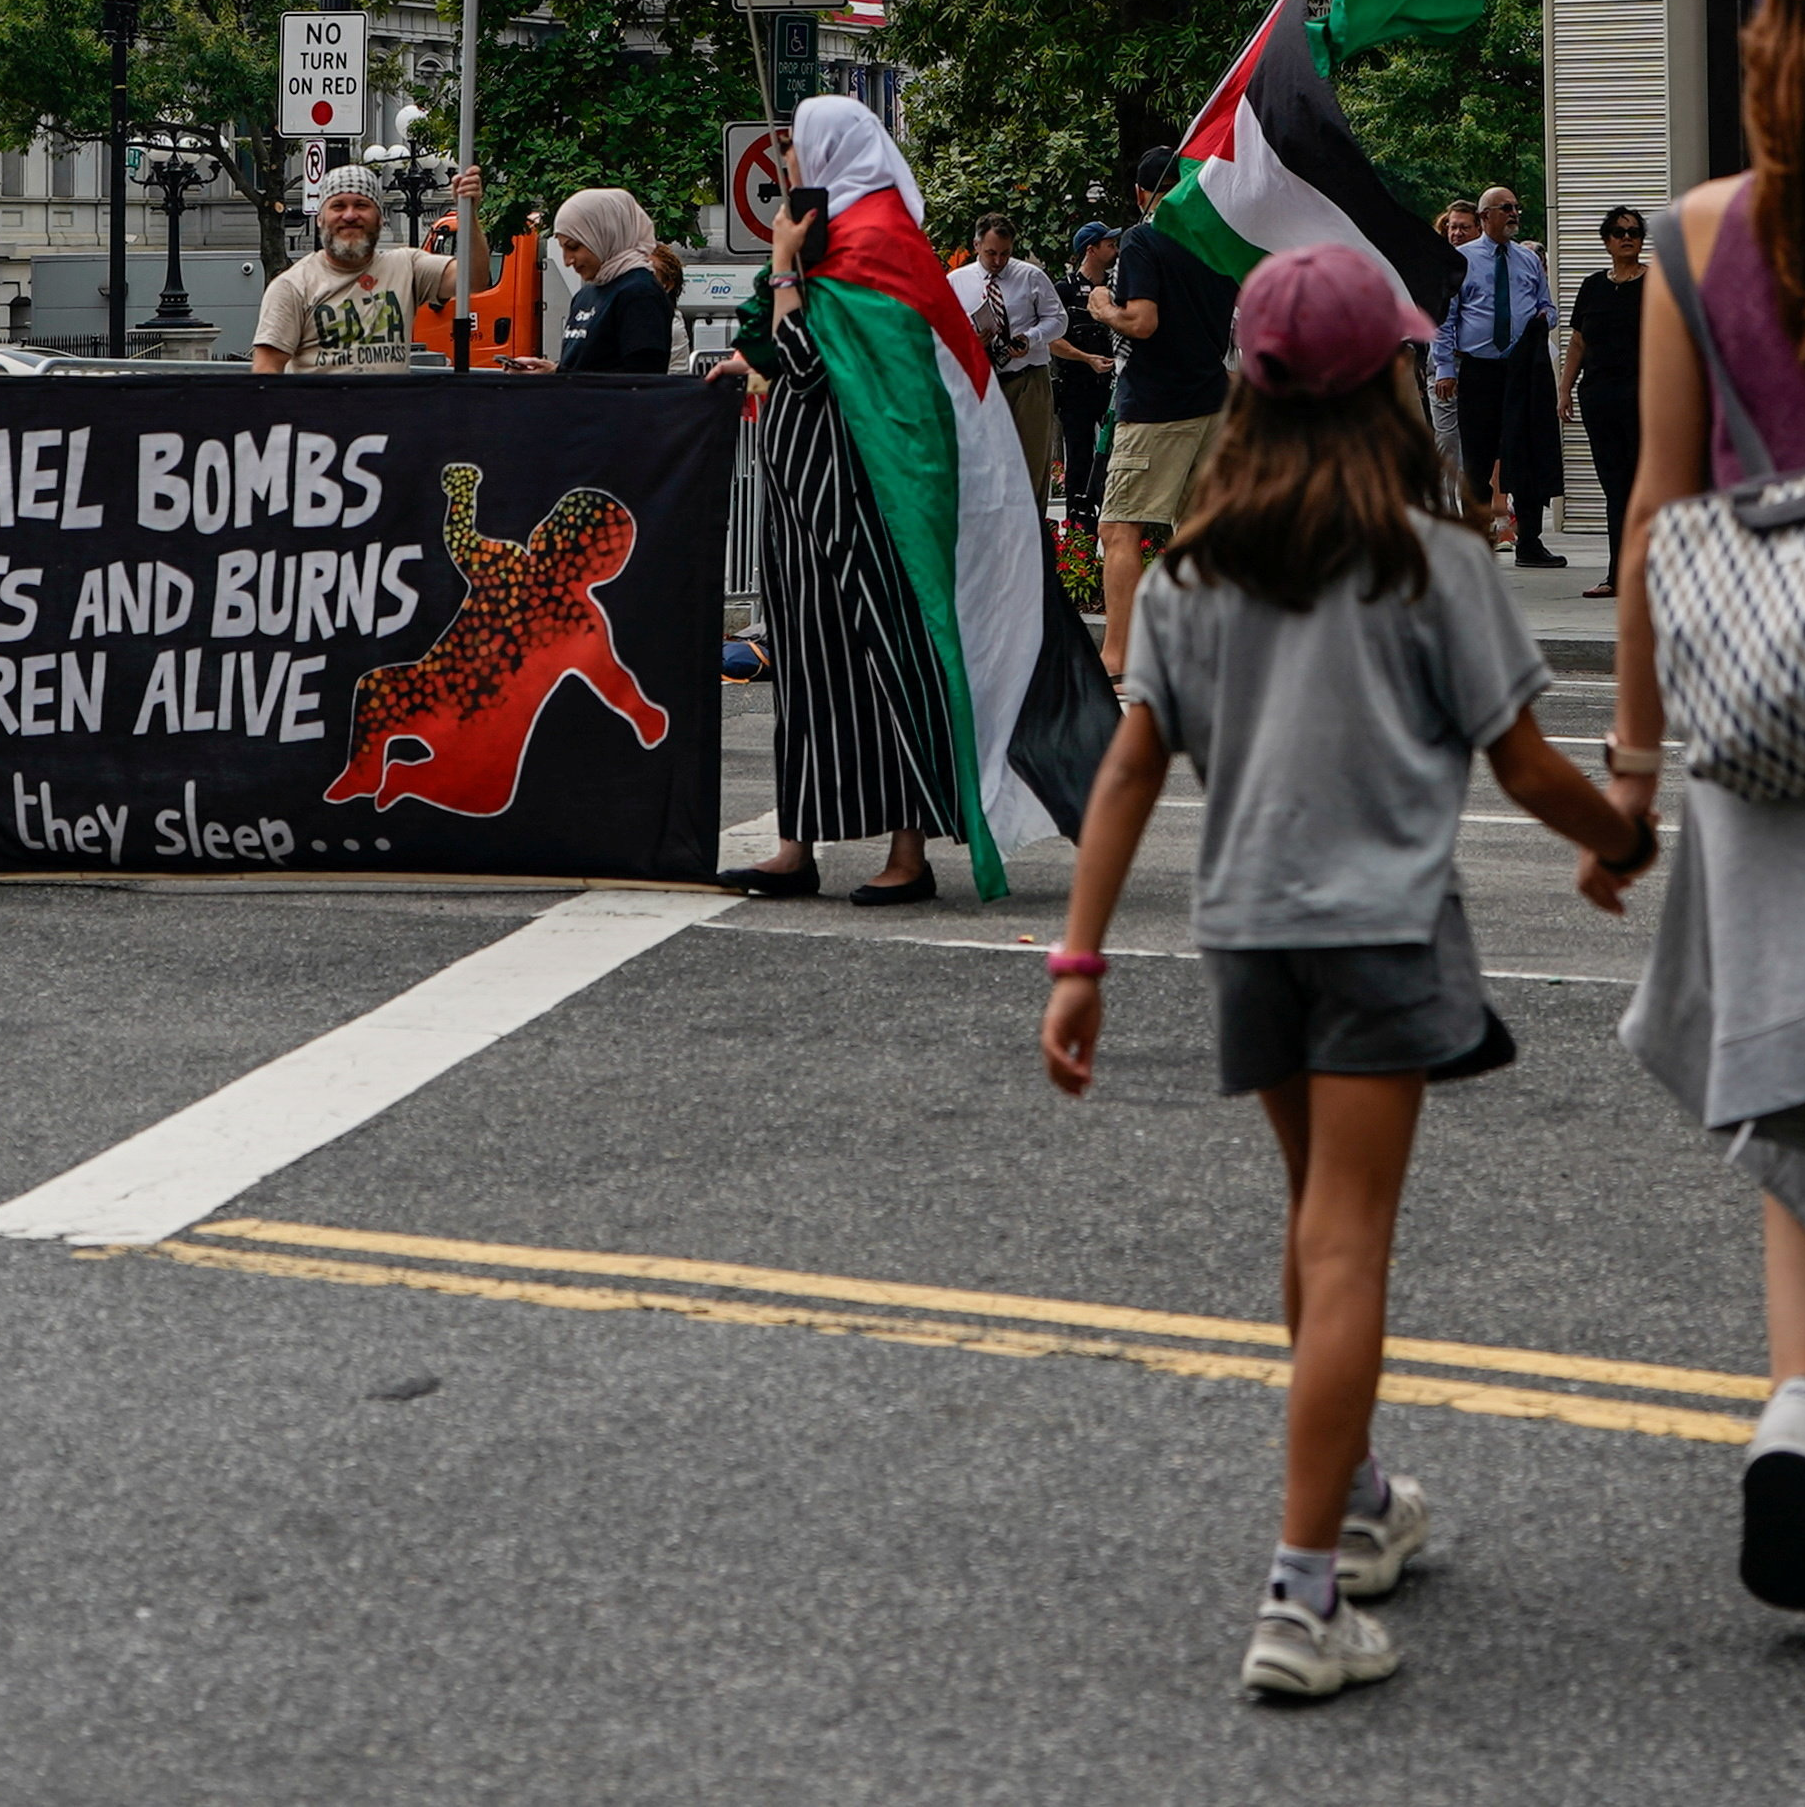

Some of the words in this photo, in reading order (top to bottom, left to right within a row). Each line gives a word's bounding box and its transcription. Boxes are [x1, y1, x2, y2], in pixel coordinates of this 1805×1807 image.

[306, 23, 342, 45] NO
[300, 52, 348, 70] TURN
[778, 61, 798, 75] DROP
[800, 61, 815, 75] OFF
[289, 77, 313, 95] ON
[322, 77, 357, 95] RED
[786, 79, 807, 92] ZONE
[710, 285, 731, 295] BIO
[313, 290, 405, 350] GAZA
[314, 351, 327, 367] IS
[331, 350, 354, 366] THE
[357, 345, 408, 365] COMPASS
[137, 423, 390, 534] BOMBS
[69, 559, 195, 639] AND
[211, 543, 424, 642] BURNS
[133, 649, 326, 743] ALIVE
[13, 770, 129, 866] they
